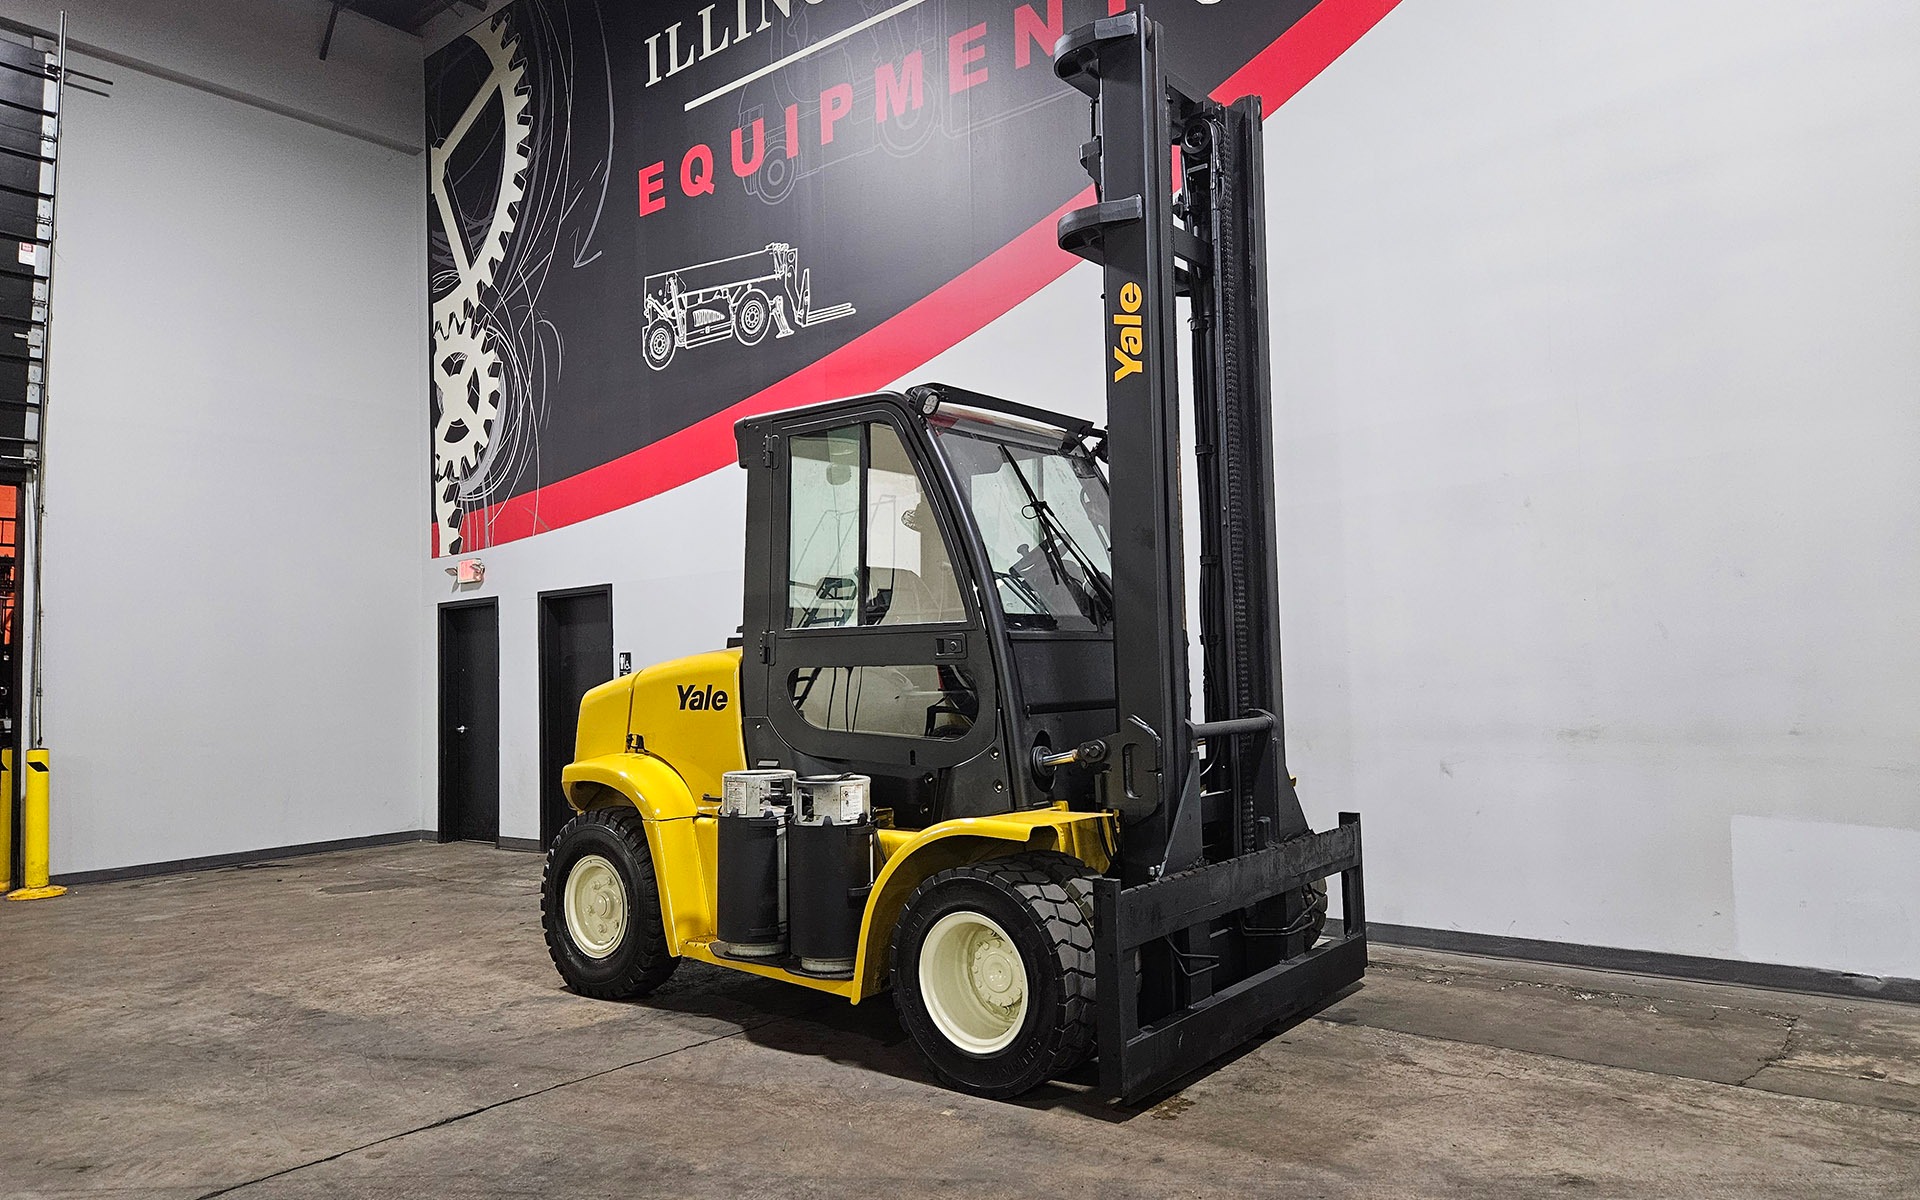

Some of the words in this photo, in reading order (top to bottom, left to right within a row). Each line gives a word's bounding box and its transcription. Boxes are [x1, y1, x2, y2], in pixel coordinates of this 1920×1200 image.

[644, 0, 824, 88] ILLI
[638, 0, 1126, 217] EQUIPMEN
[1114, 281, 1143, 382] Yale
[676, 684, 729, 712] Yale
